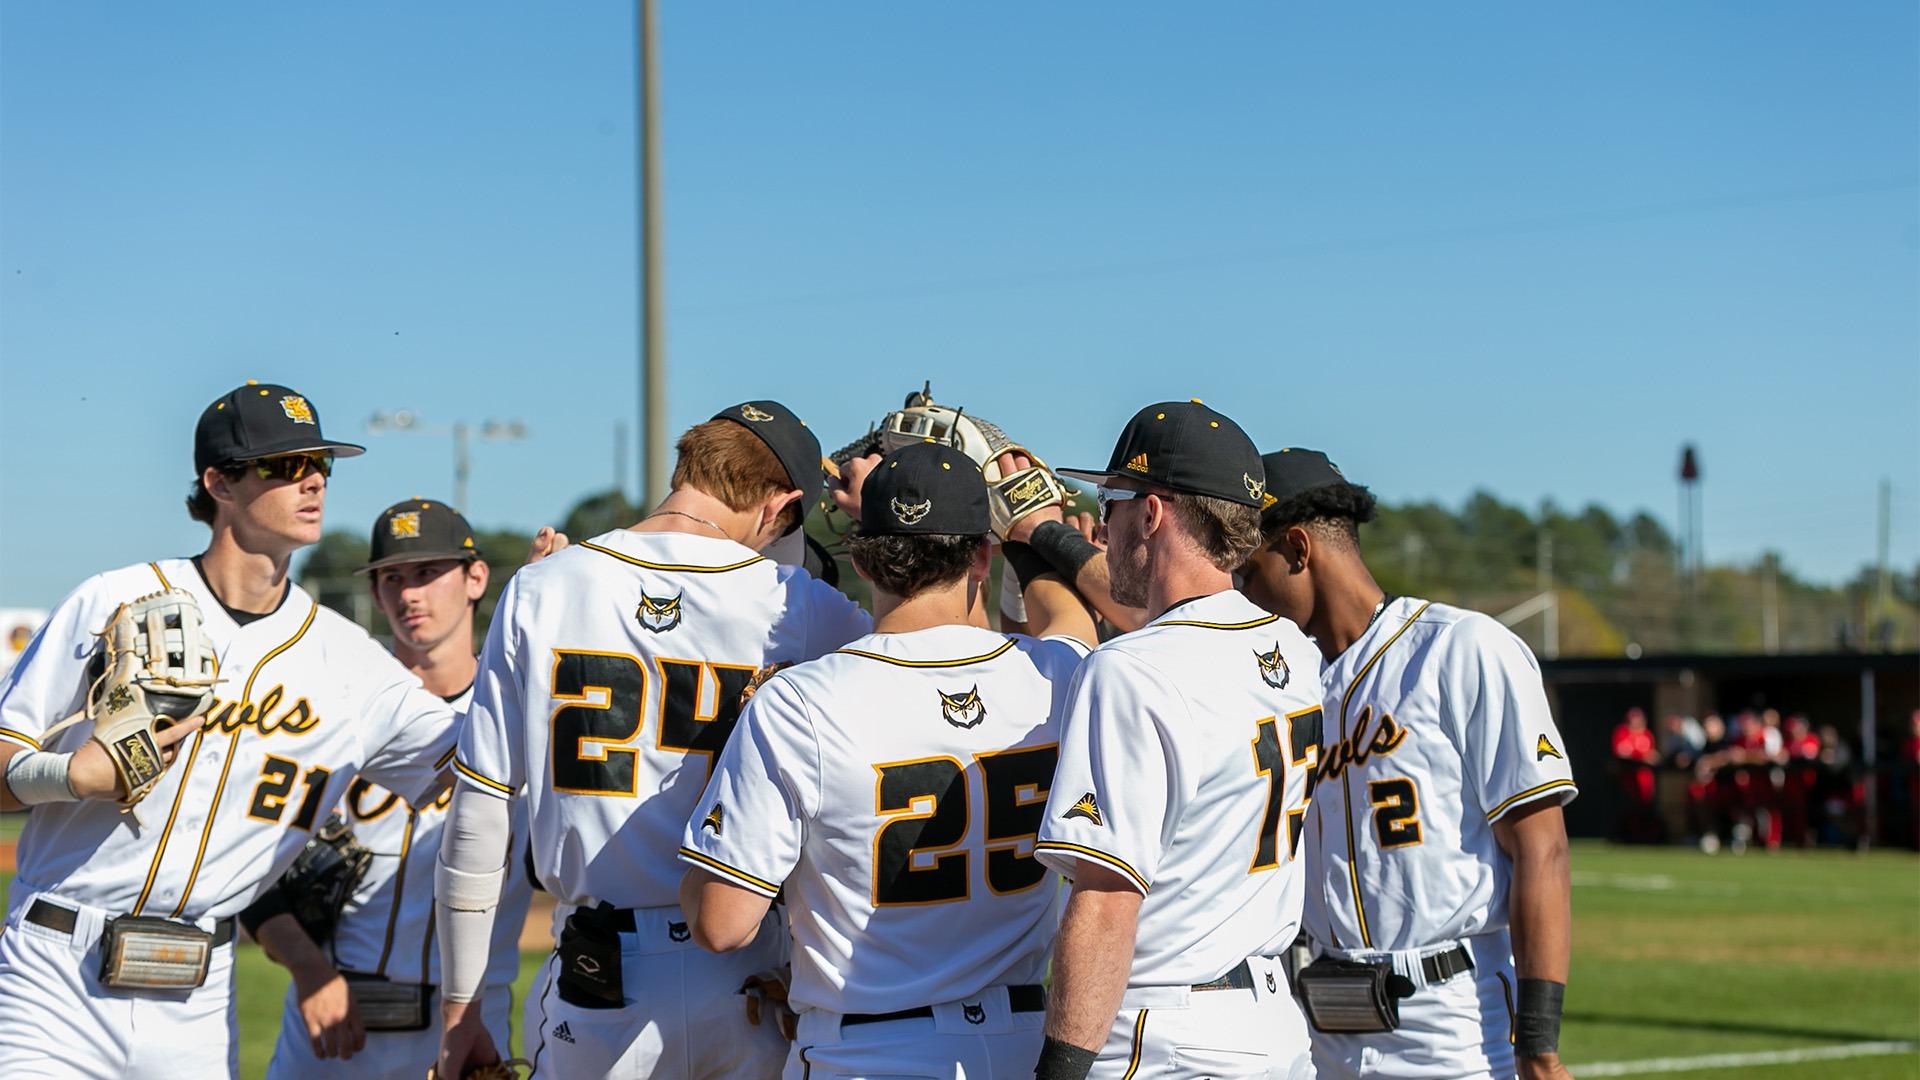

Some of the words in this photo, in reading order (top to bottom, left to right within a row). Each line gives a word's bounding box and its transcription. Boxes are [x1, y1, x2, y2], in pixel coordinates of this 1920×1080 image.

[201, 684, 320, 738] wls
[551, 648, 758, 800] 24
[1317, 704, 1408, 784] wls
[246, 753, 332, 832] 21
[871, 742, 1060, 907] 25
[1366, 776, 1424, 848] 2
